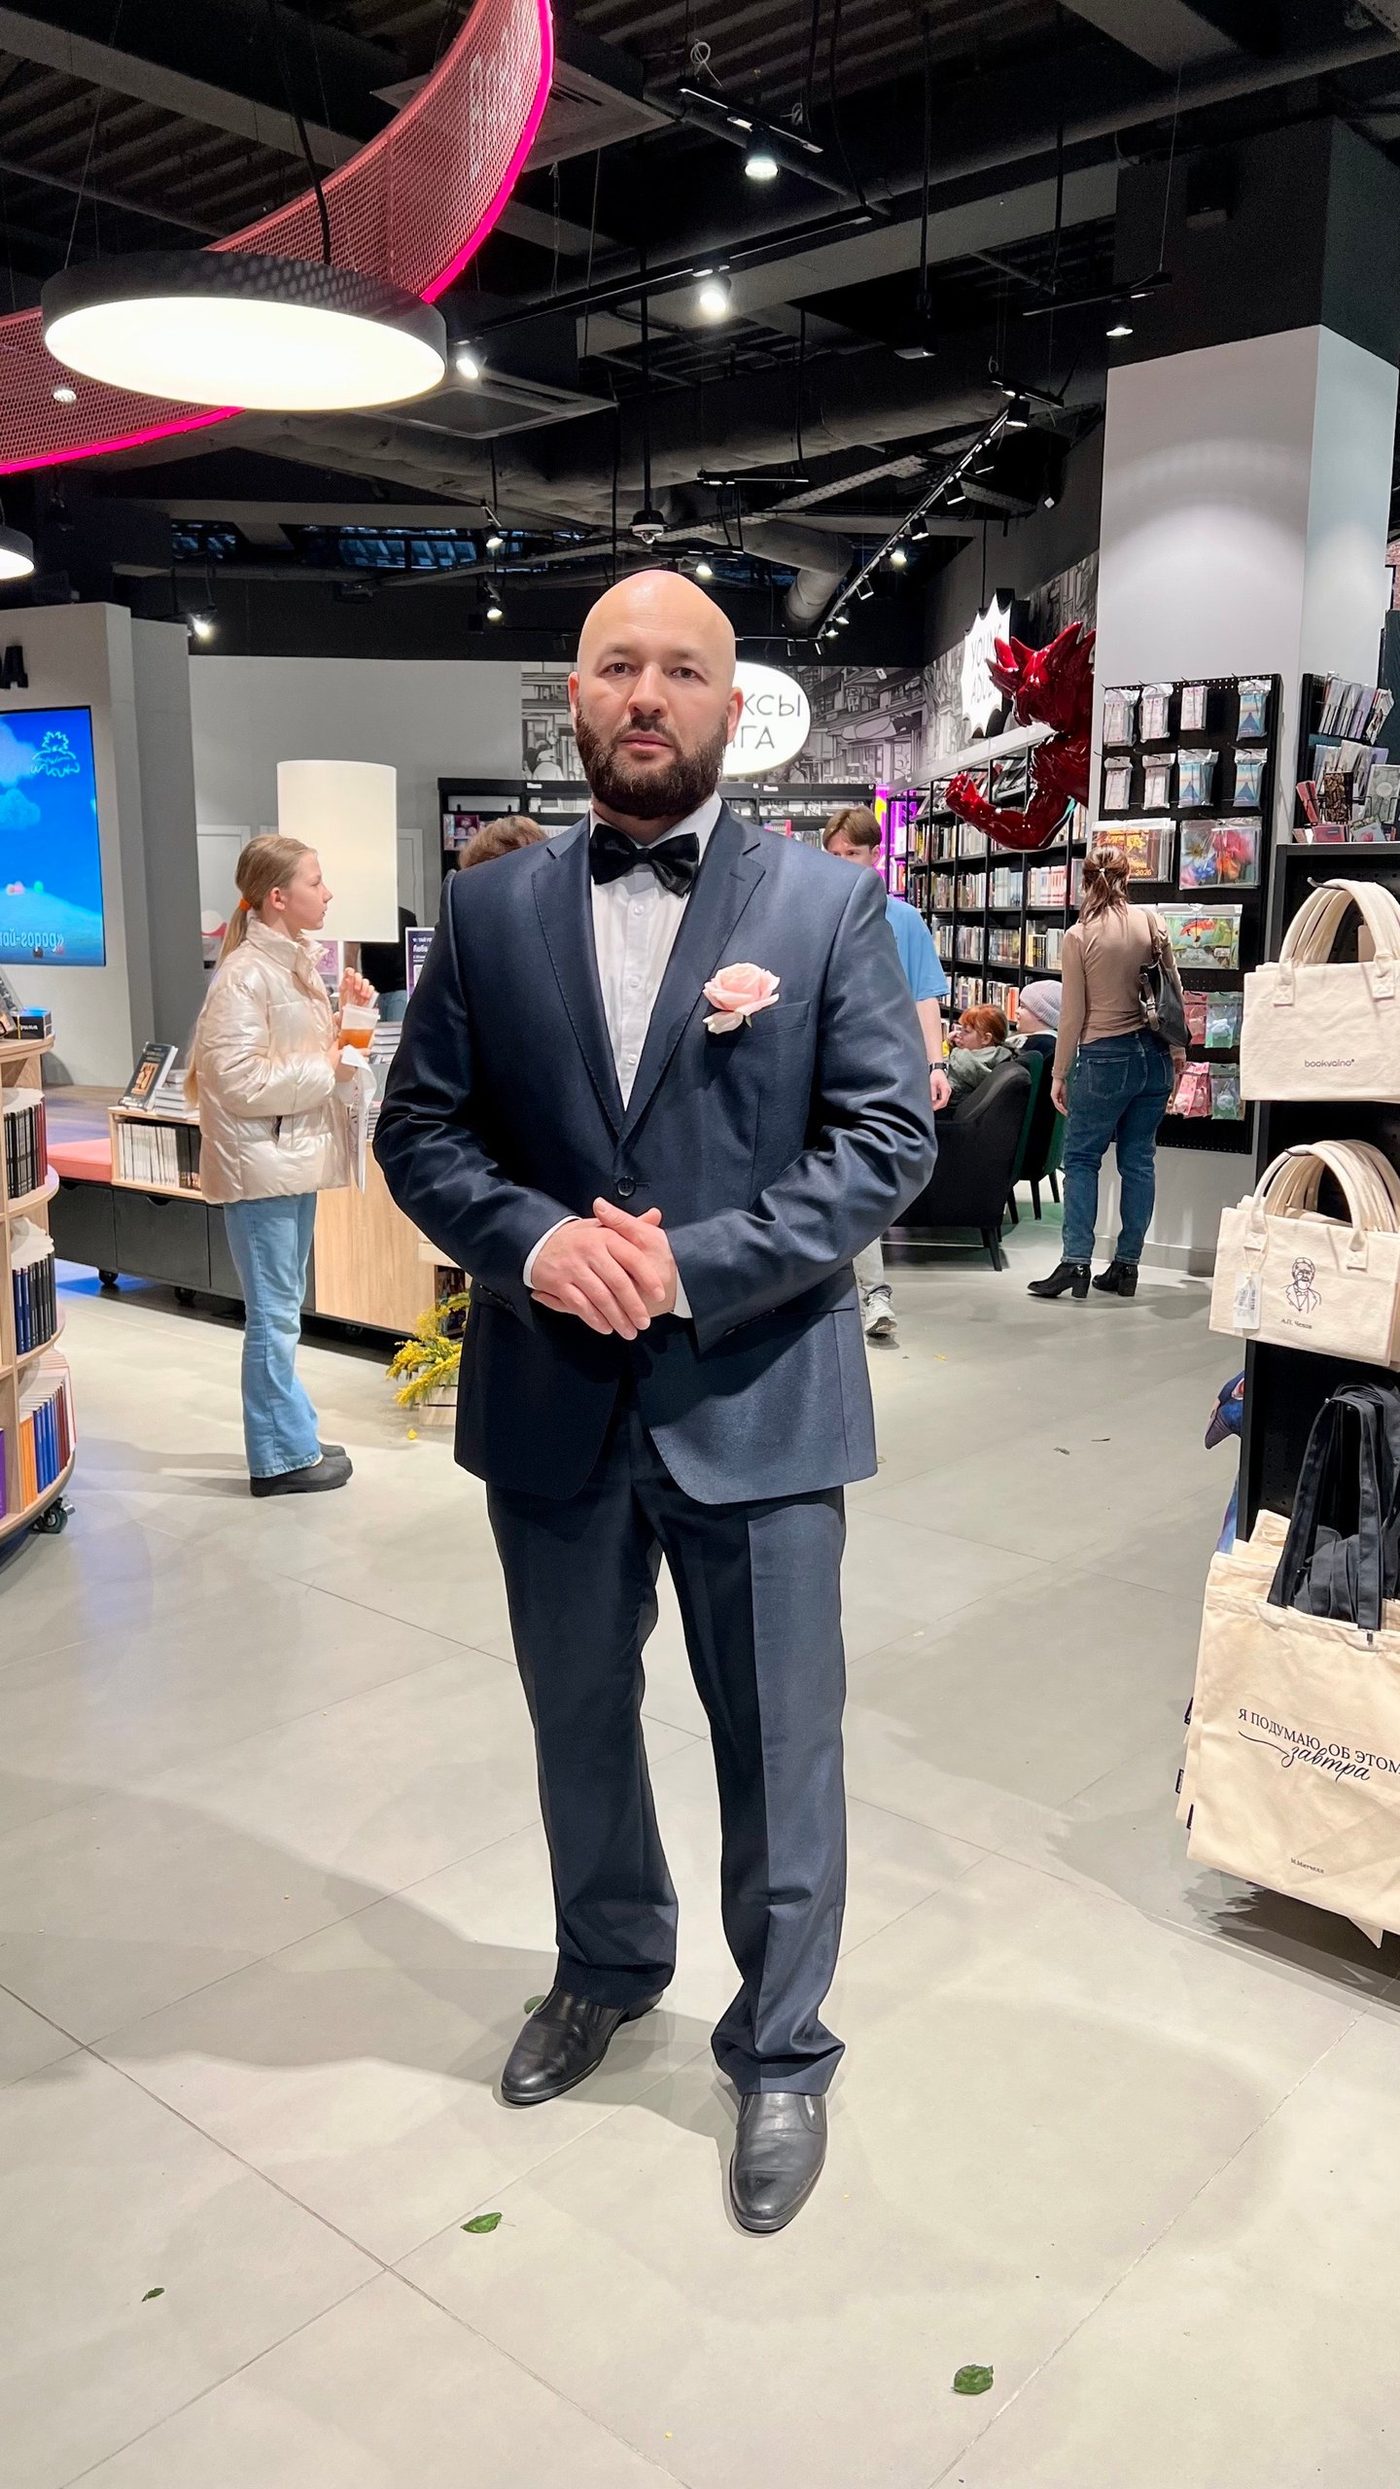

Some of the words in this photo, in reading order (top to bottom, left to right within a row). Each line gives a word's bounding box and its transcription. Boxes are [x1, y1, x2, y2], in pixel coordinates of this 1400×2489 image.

[0, 645, 28, 689] А
[743, 693, 801, 717] КСЫ
[733, 725, 775, 749] ГА
[0, 927, 64, 953] ай-город»
[1238, 1708, 1247, 1721] Я
[1251, 1711, 1321, 1750] ПОДУМАЮ
[1328, 1743, 1351, 1760] ОБ
[1354, 1750, 1400, 1775] ЭТОМ
[1280, 1745, 1371, 1783] завтра
